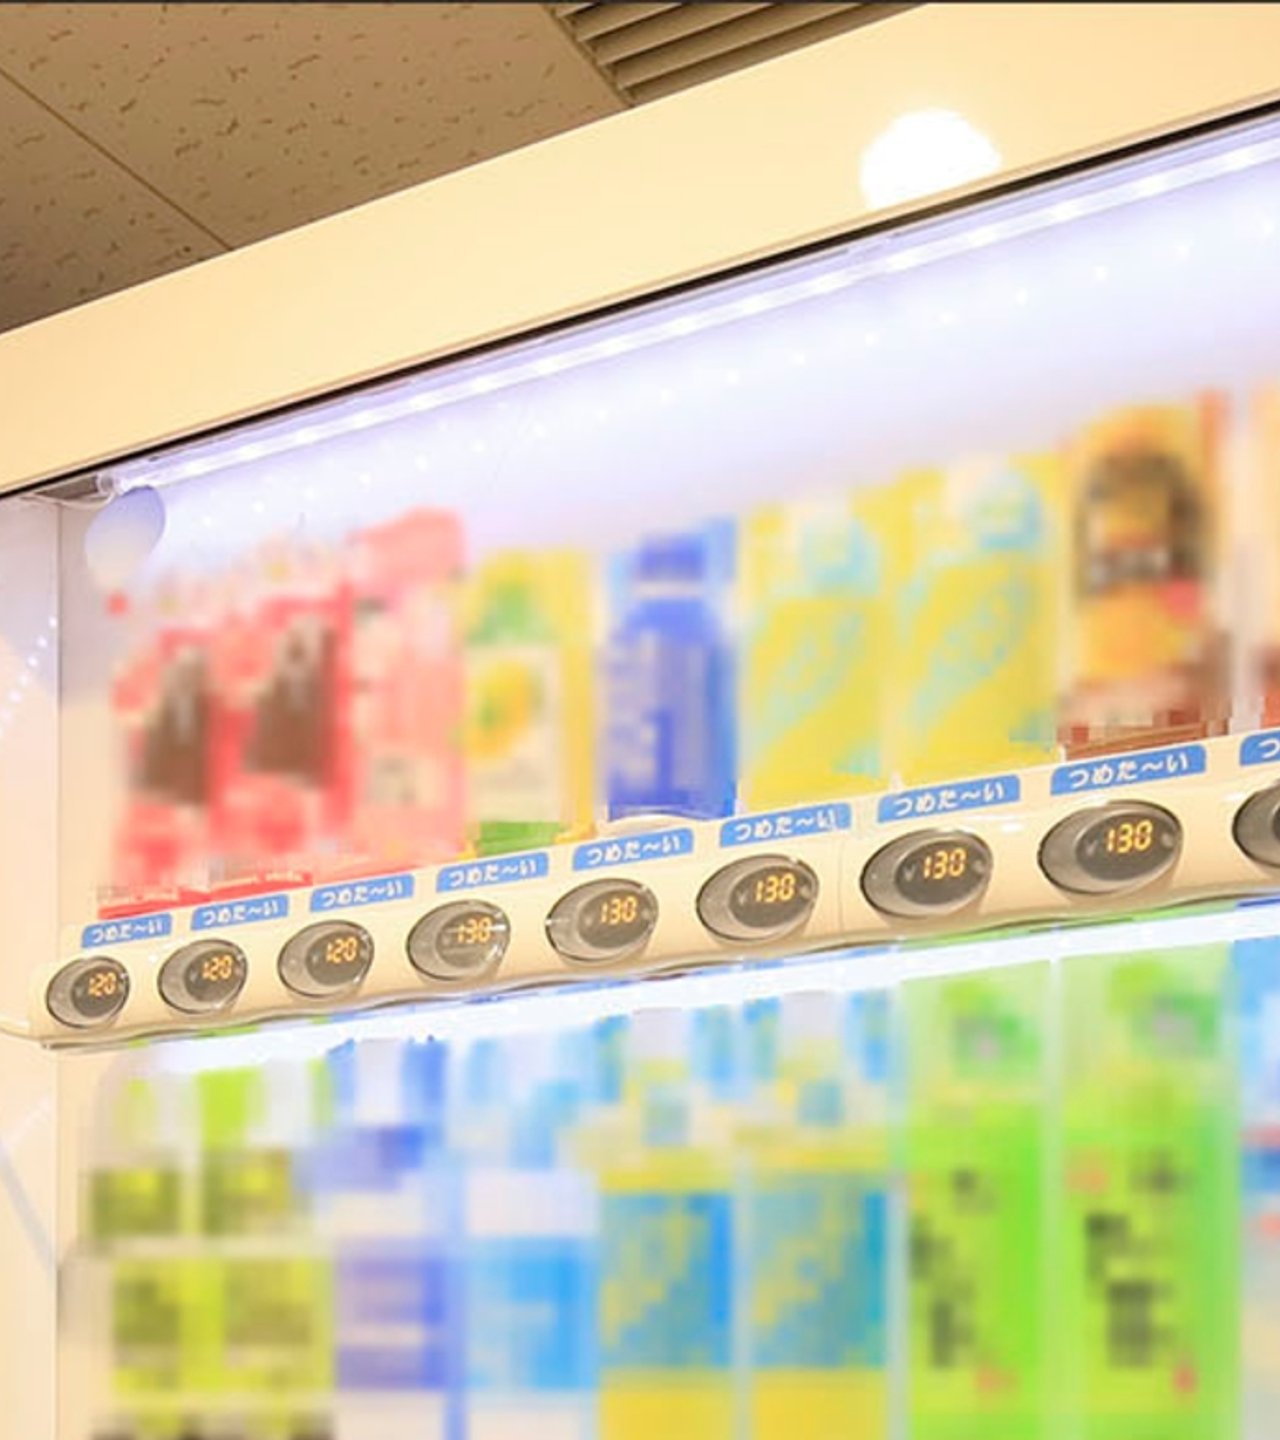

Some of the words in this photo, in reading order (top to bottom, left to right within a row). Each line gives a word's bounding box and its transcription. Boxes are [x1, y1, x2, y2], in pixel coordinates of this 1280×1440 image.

[1103, 819, 1153, 855] 130
[922, 847, 967, 880] 130
[755, 873, 796, 904] 130
[599, 896, 637, 926] 130
[325, 936, 358, 964] 120
[202, 954, 233, 981] 120
